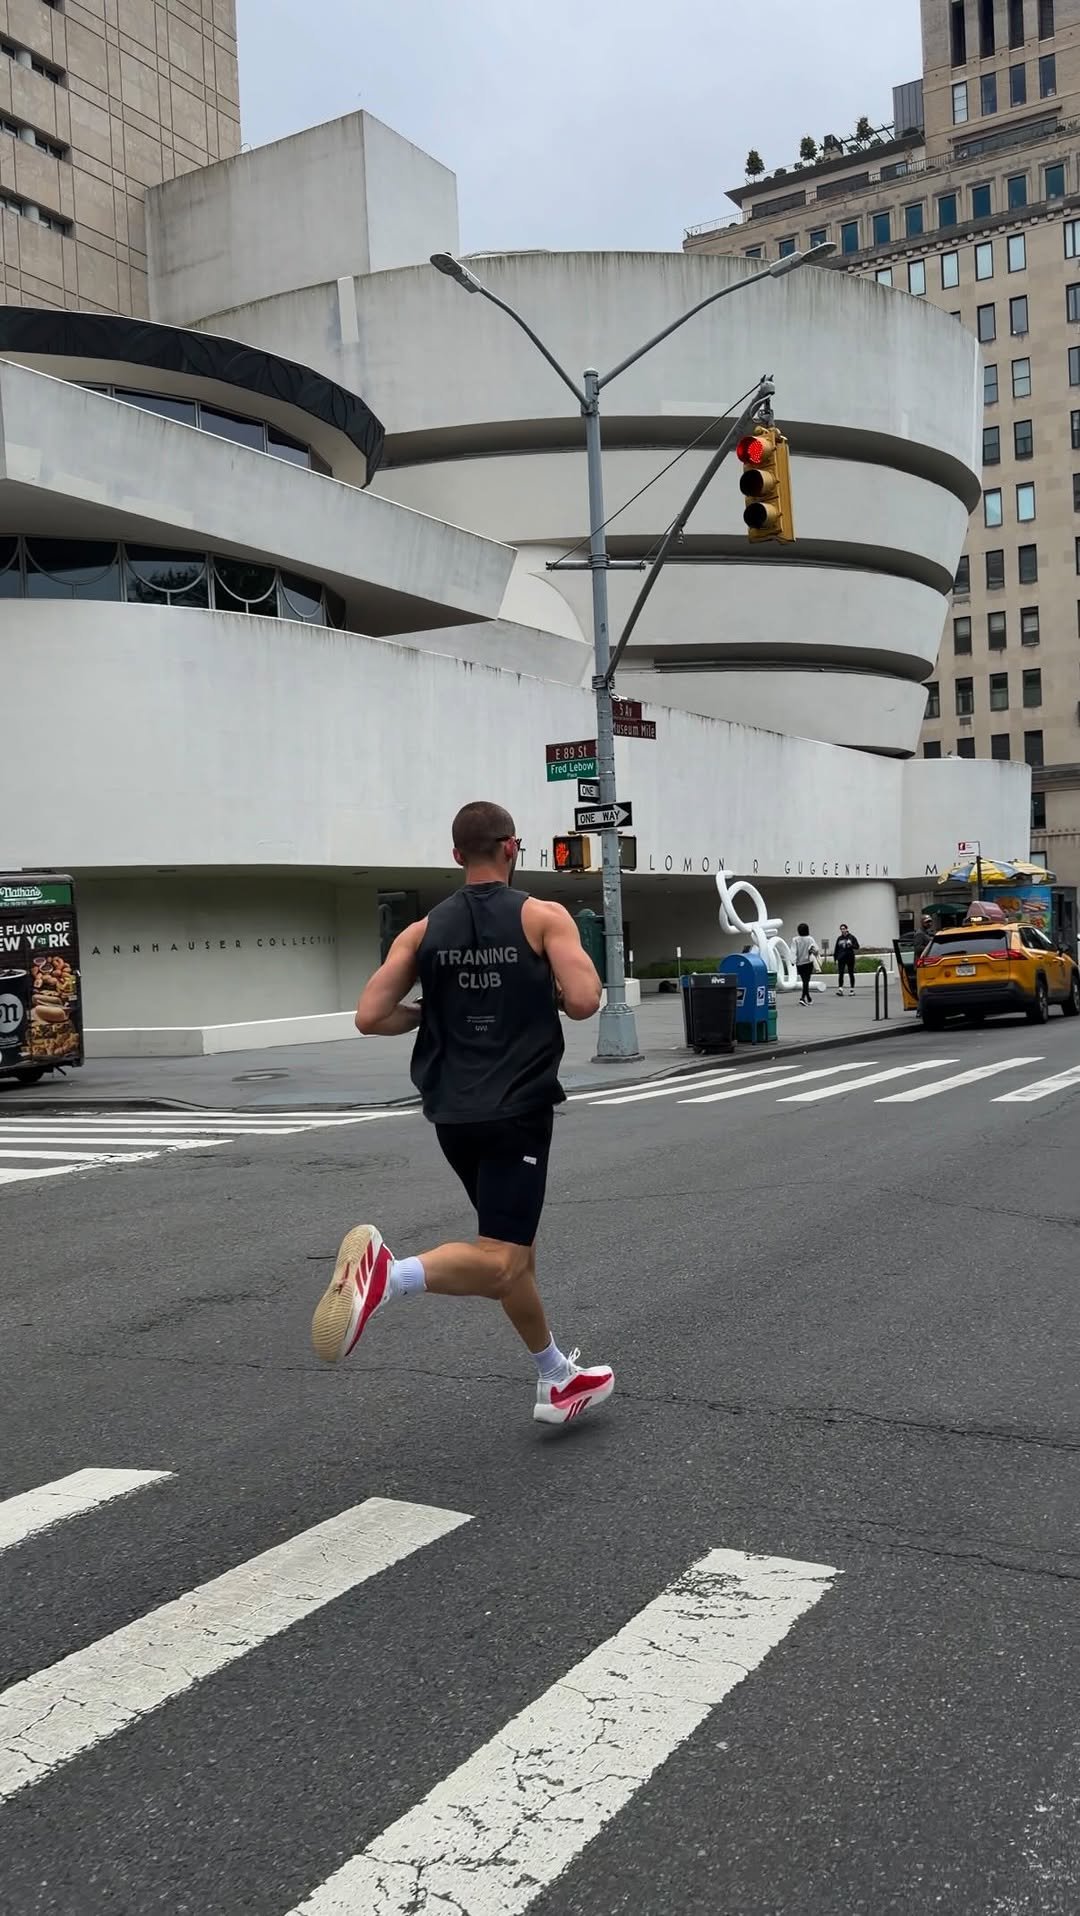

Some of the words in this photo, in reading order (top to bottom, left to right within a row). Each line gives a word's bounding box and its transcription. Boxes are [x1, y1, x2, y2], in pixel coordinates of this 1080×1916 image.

[625, 705, 632, 717] Av
[641, 722, 655, 738] Mile
[555, 748, 561, 760] E
[563, 747, 575, 759] 89
[577, 745, 588, 758] St
[550, 763, 567, 774] Fred
[569, 761, 594, 772] Lebow
[581, 786, 595, 796] ONE
[580, 813, 596, 824] ONE
[602, 810, 621, 822] WAY
[518, 848, 549, 868] TH
[752, 859, 760, 873] R
[784, 860, 889, 876] GUGGENHEIM
[6, 924, 52, 936] FLAVOR
[54, 921, 70, 932] OF
[458, 971, 502, 989] CLUB
